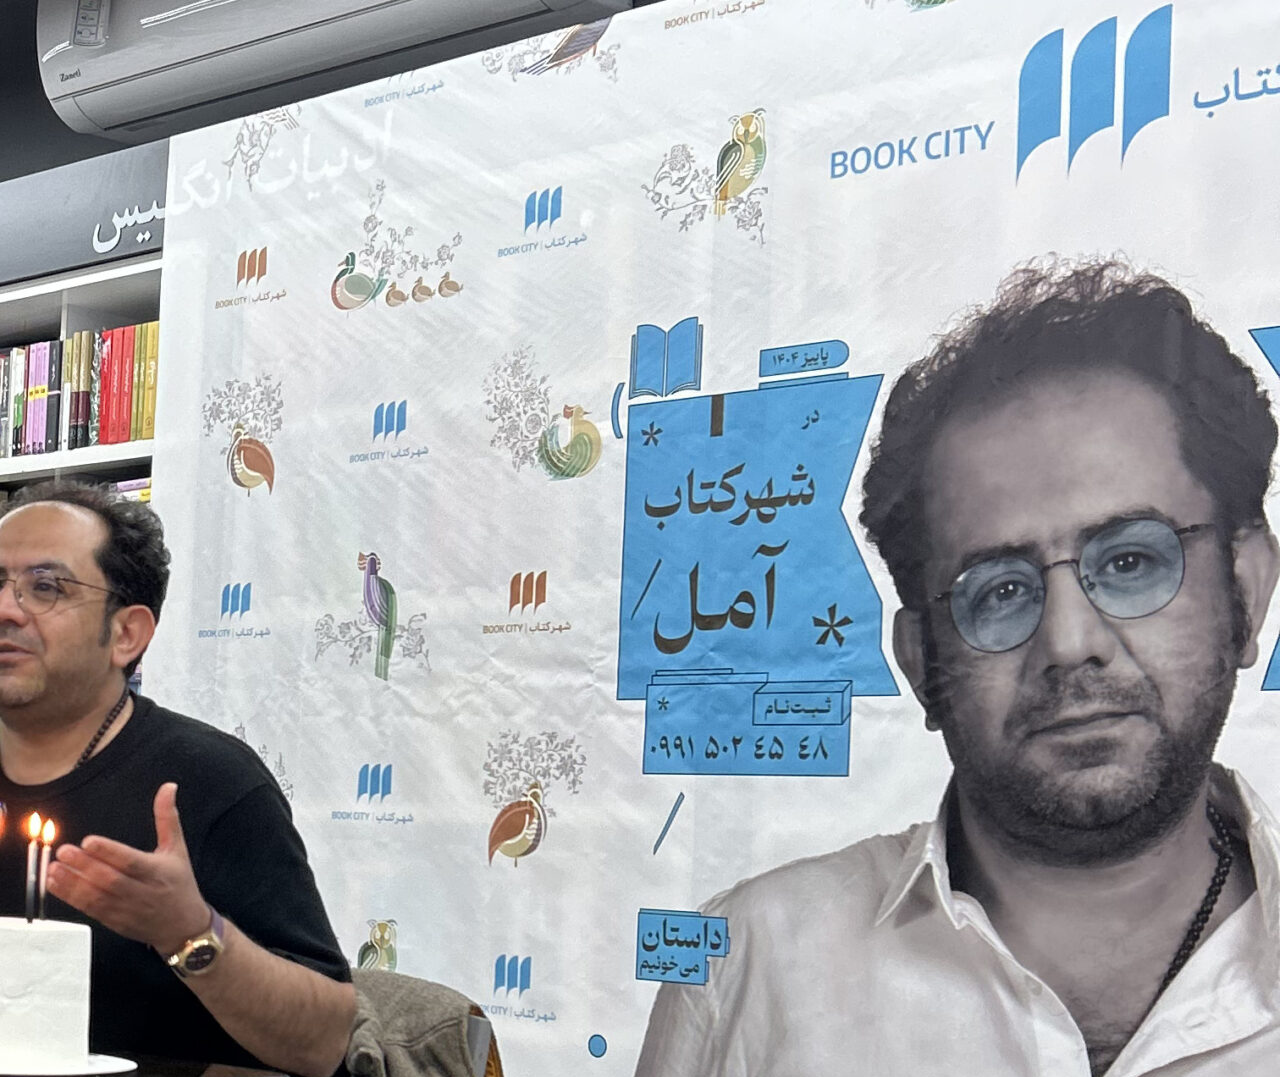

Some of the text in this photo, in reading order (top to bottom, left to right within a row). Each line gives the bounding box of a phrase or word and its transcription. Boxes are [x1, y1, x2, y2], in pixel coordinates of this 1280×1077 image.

[830, 121, 996, 179] BOOK CITY
[801, 347, 830, 368] پاییز
[801, 409, 820, 430] در
[653, 540, 791, 656] آمل
[651, 735, 694, 760] ۰۹۹۱
[704, 735, 743, 760] ۵۰۲
[641, 916, 723, 953] داستان
